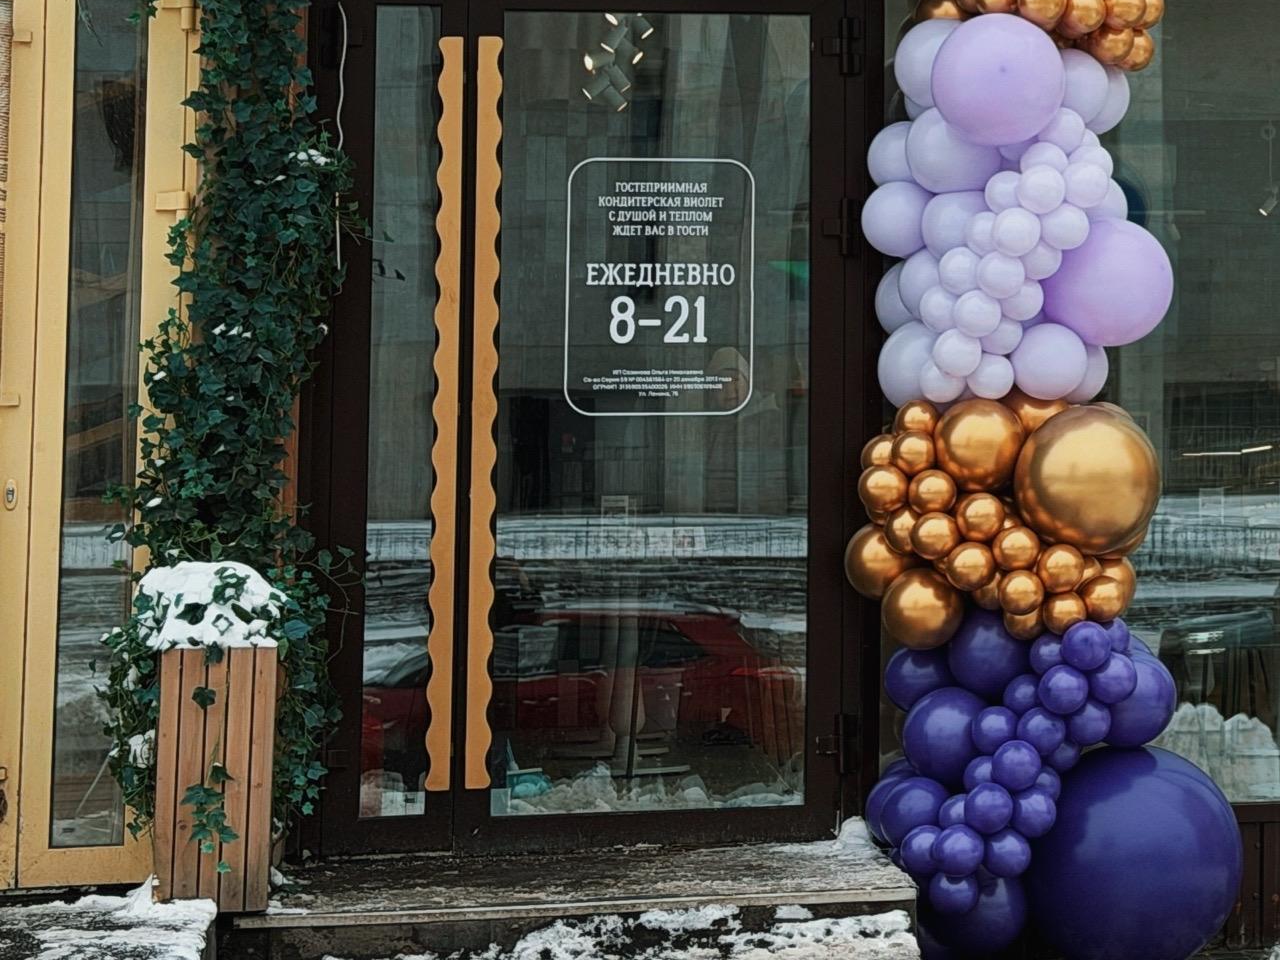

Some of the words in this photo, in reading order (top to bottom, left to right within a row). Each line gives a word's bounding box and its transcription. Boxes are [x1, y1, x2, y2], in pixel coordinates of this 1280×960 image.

[615, 182, 708, 193] ГОСТЕПРИИМНАЯ
[598, 196, 681, 208] КОНДИТЕРСКАЯ
[683, 197, 724, 208] ВИОЛЕТ
[608, 211, 616, 222] С
[617, 209, 657, 223] ДУШОЙ
[659, 211, 667, 222] И
[669, 211, 713, 222] ТЕПЛОМ
[612, 225, 643, 237] ЖДЕТ
[644, 225, 666, 236] ВАС
[667, 225, 675, 236] В
[676, 225, 709, 236] ГОСТИ
[586, 262, 736, 287] ЕЖЕДНЕВНО
